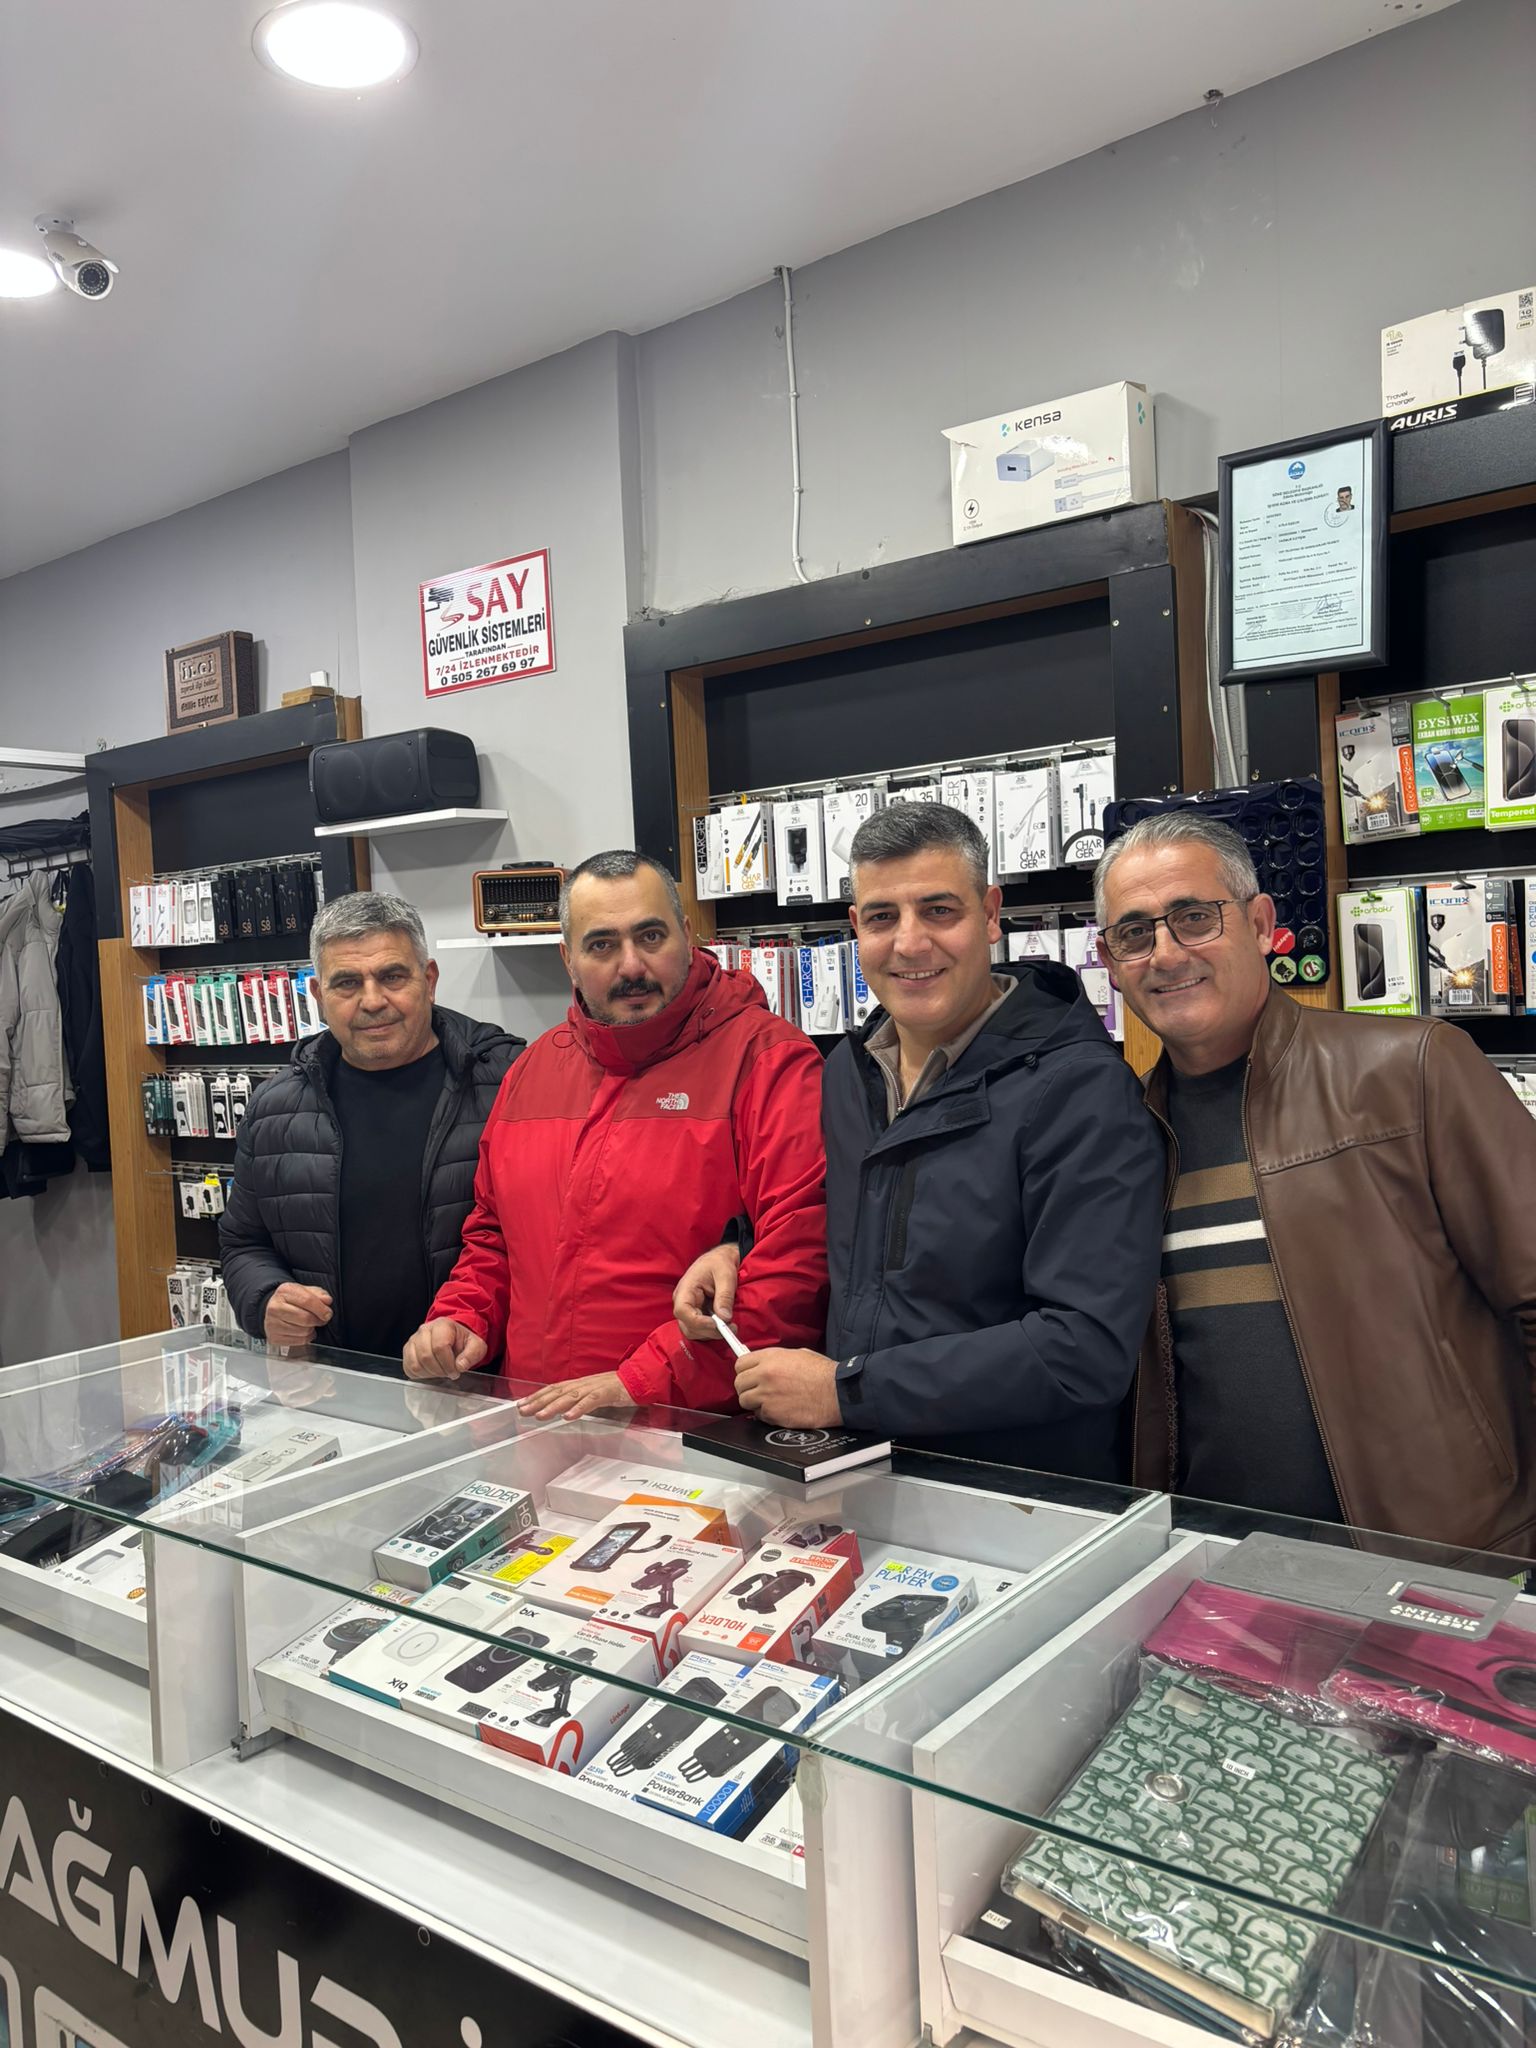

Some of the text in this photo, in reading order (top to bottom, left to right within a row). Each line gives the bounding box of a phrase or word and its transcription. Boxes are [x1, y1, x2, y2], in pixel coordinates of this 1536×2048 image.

[1386, 390, 1409, 402] Travel
[1386, 397, 1416, 409] Charger
[1390, 404, 1458, 431] AURIS
[466, 568, 529, 622] SAY
[428, 607, 546, 657] GÜVENLİK SİSTEMLERİ
[465, 643, 506, 658] TARAFINDAN
[436, 645, 540, 676] 7/24 İZLENMEKTEDİR
[441, 657, 535, 686] 0 505 267 69 97
[1418, 713, 1479, 729] BYSiWiX
[855, 793, 868, 807] 20
[1491, 808, 1535, 818] Tempered
[1075, 839, 1102, 850] CHAR
[1020, 850, 1046, 860] CHAR
[1075, 848, 1094, 859] GER
[1020, 859, 1039, 870] GER
[741, 873, 761, 882] CHAR
[741, 881, 756, 890] GER
[241, 922, 252, 934] S8
[260, 919, 271, 931] S8
[286, 917, 297, 929] S8
[218, 924, 229, 936] S8
[800, 950, 814, 1005] CHARGER
[856, 943, 868, 1000] CHAR
[465, 1483, 520, 1503] HOLDER
[875, 1569, 927, 1588] PLAYER
[914, 1568, 934, 1580] FM
[1391, 1604, 1481, 1626] ANTI-SLIP
[698, 1614, 748, 1632] HOLDER
[845, 1632, 876, 1644] DUAL USB
[1234, 1766, 1250, 1777] INCH
[646, 1779, 705, 1806] PowerBank
